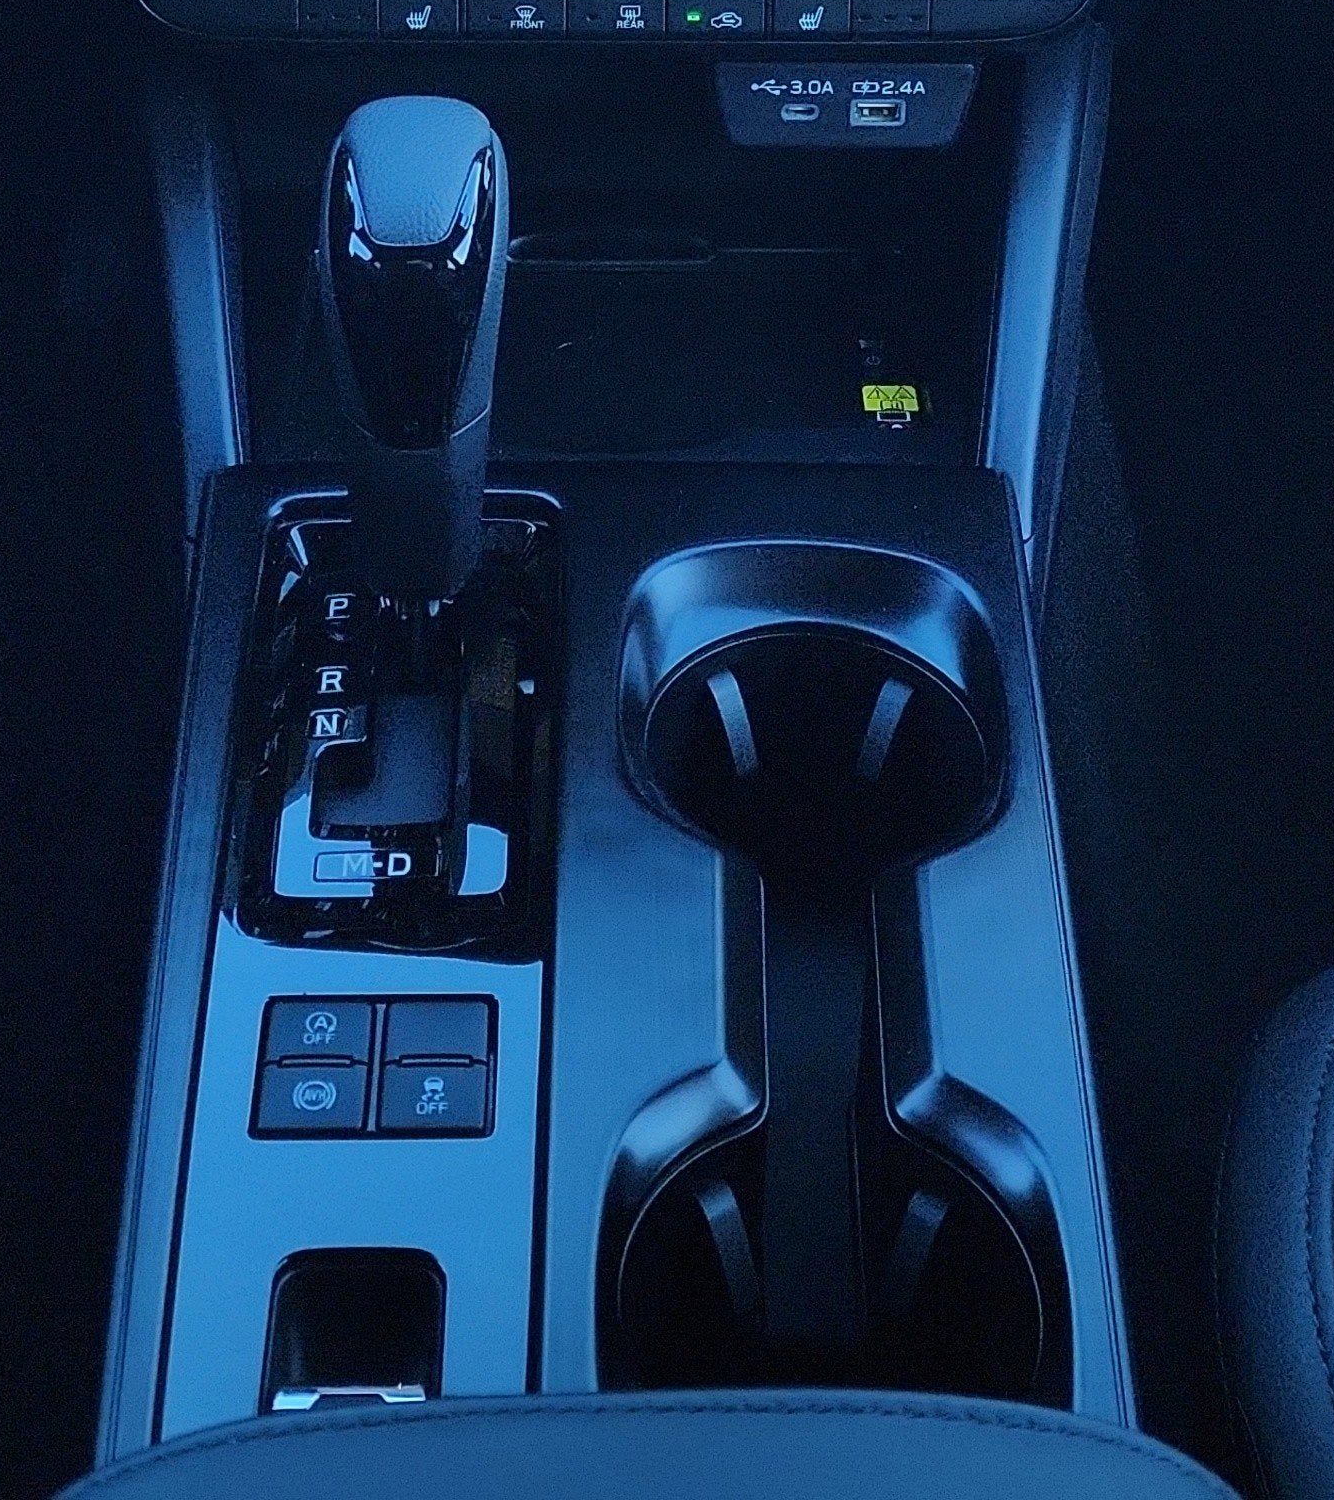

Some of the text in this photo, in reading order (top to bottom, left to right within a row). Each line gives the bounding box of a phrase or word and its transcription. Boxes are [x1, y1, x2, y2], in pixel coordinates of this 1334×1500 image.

[510, 20, 545, 29] FRONT
[616, 19, 644, 29] REAR
[790, 80, 834, 95] 3.0A
[881, 80, 926, 95] 2.4A
[329, 597, 349, 618] P
[320, 670, 343, 692] R
[315, 713, 340, 736] N
[303, 1033, 336, 1045] OFF
[417, 1102, 448, 1115] OFF
